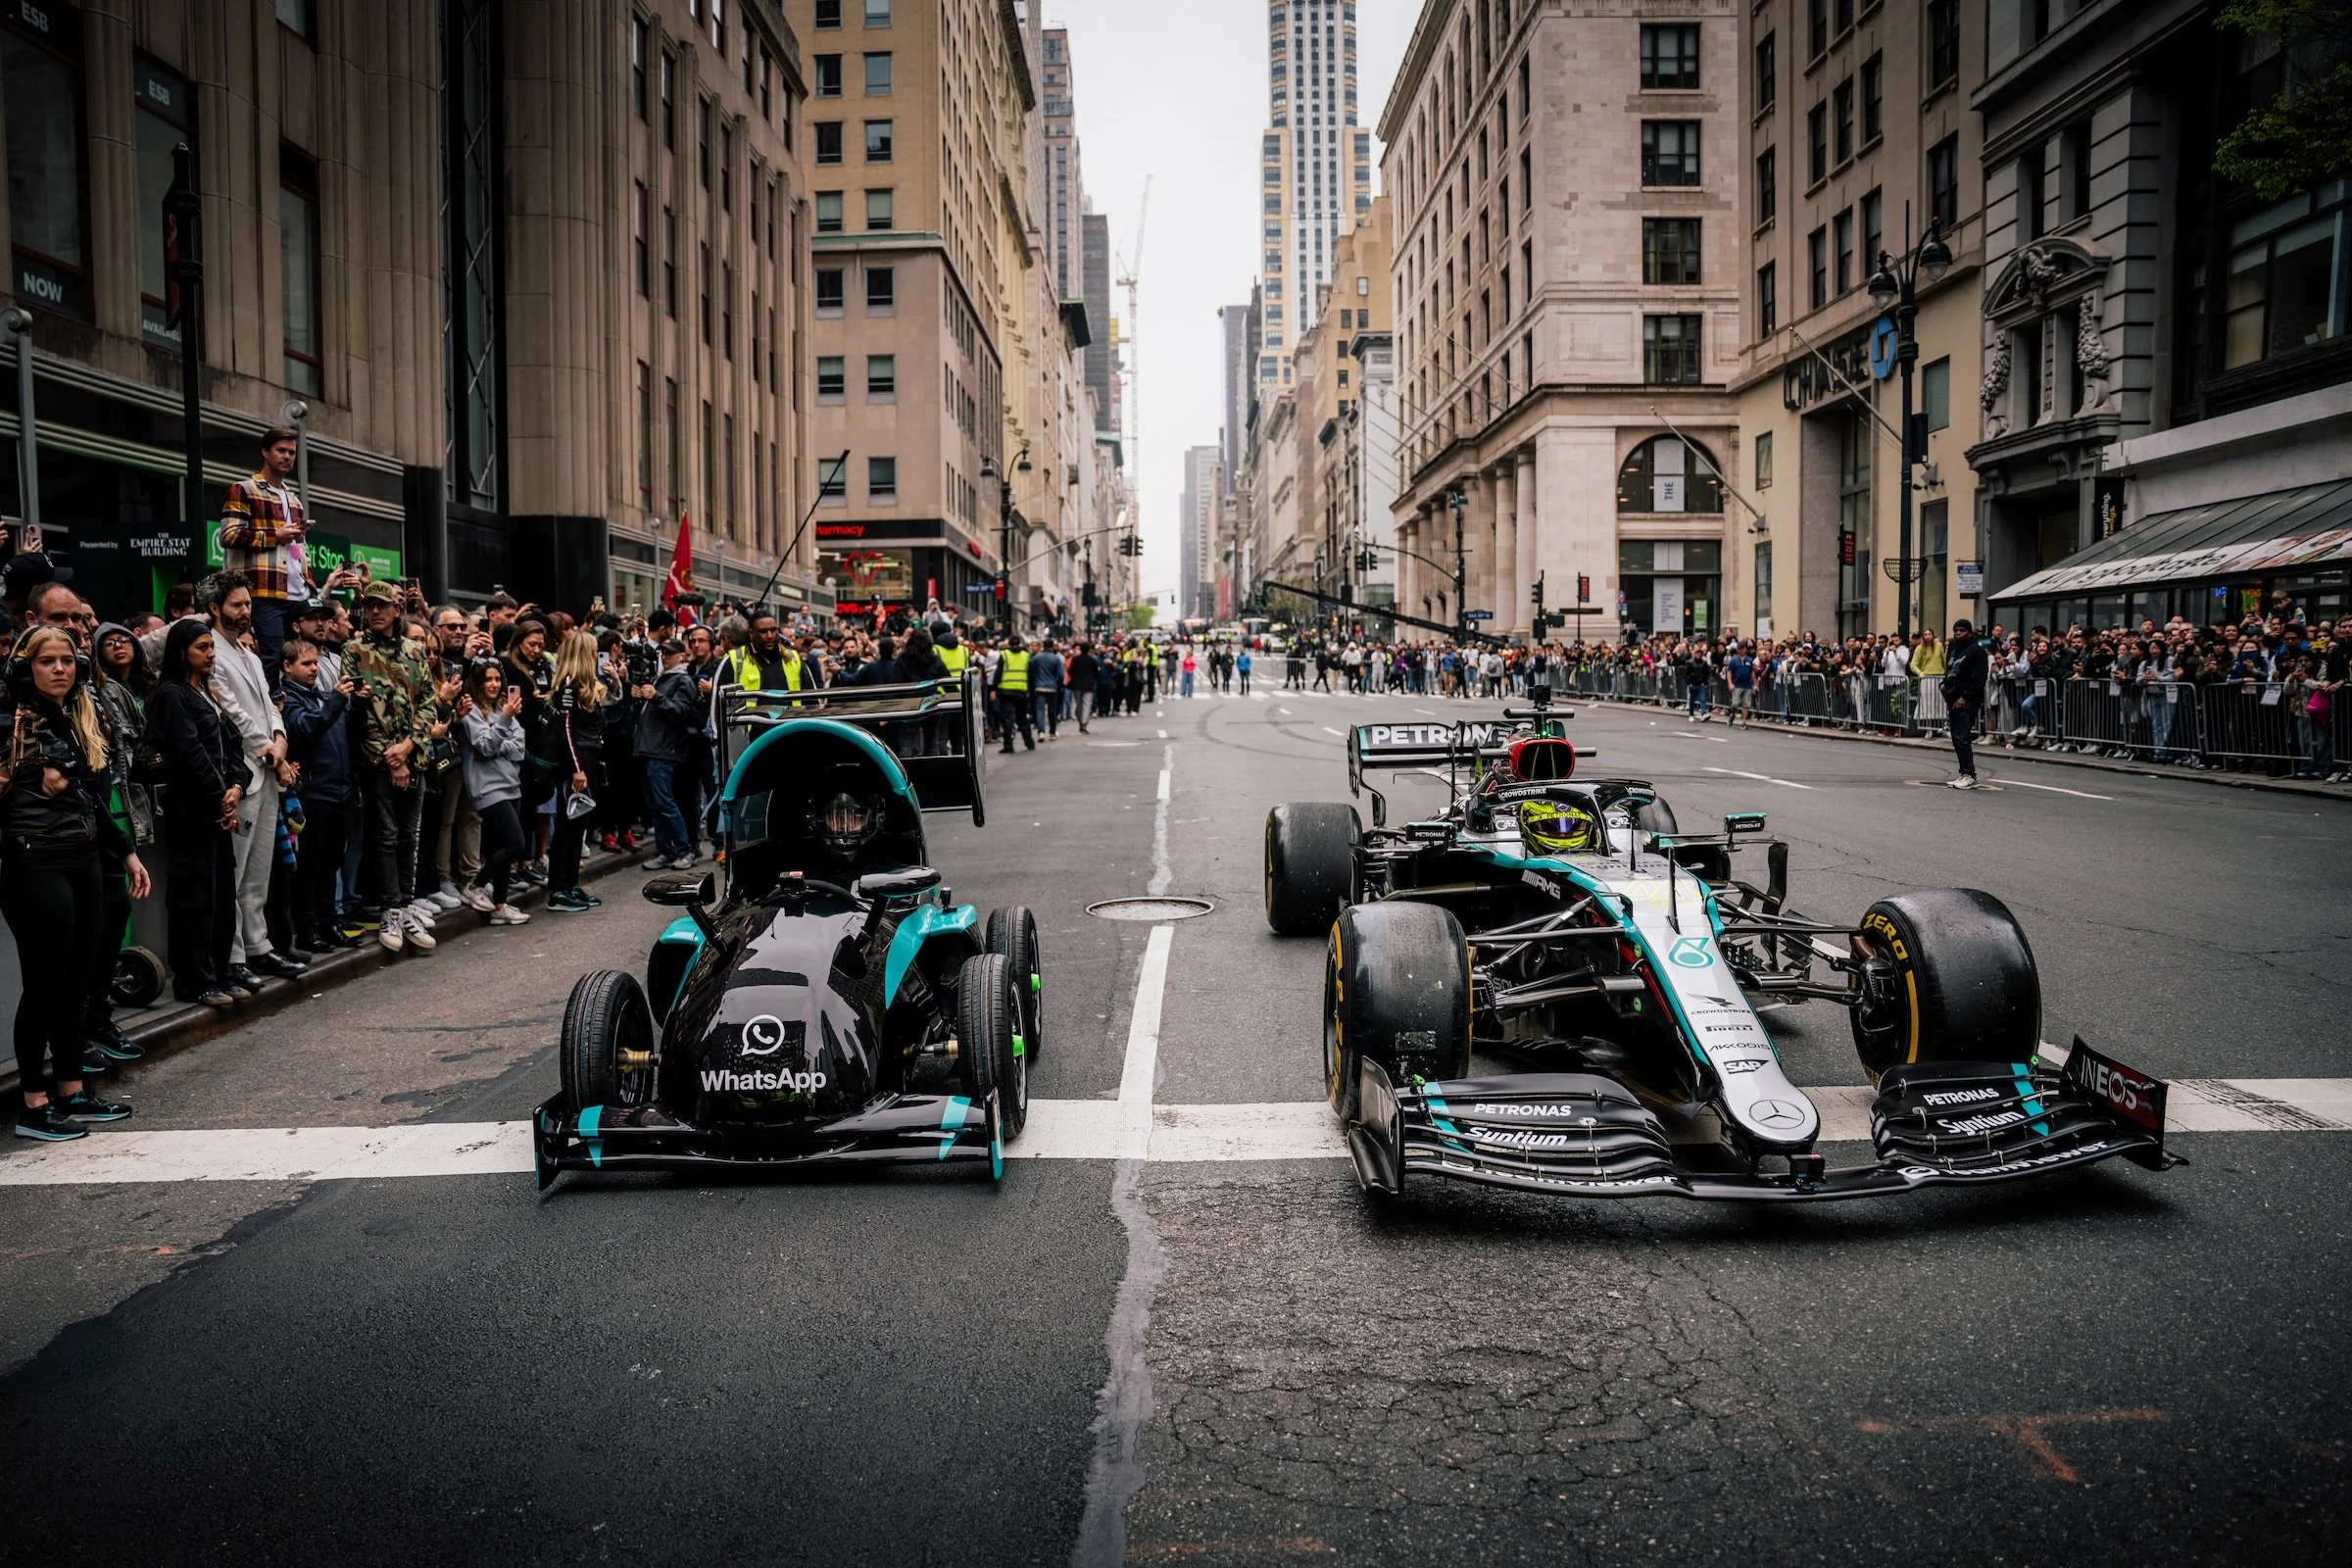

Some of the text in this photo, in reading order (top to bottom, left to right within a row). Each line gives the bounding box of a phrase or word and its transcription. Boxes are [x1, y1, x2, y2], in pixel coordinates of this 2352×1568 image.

[21, 1, 49, 33] ESB
[148, 78, 171, 106] ESB
[24, 270, 63, 303] NOW
[142, 318, 182, 342] AVAILABL
[1785, 327, 1869, 410] CHASE
[1665, 482, 1674, 501] THE
[815, 525, 864, 537] harmacy
[79, 540, 119, 550] Presented by
[130, 538, 192, 548] EMPIRE STAT
[141, 548, 187, 558] BUILDING
[307, 544, 317, 567] it
[836, 603, 858, 613] CVS
[1372, 722, 1533, 745] PETRONS
[1500, 787, 1547, 799] CROWDSTRIKE
[1494, 819, 1517, 831] G42
[1608, 816, 1630, 828] G42
[1535, 875, 1561, 900] AMG
[1864, 912, 1909, 960] ZERO
[1706, 1024, 1753, 1033] PIRELLI
[1724, 1060, 1763, 1074] SAP
[700, 1067, 827, 1094] WhatsApp
[2080, 1054, 2137, 1110] INEOS
[1923, 1088, 2000, 1106] PETRONAS
[1473, 1103, 1572, 1116] PETRONAS
[1936, 1110, 2026, 1136] Syntium
[1464, 1127, 1568, 1146] Syntium
